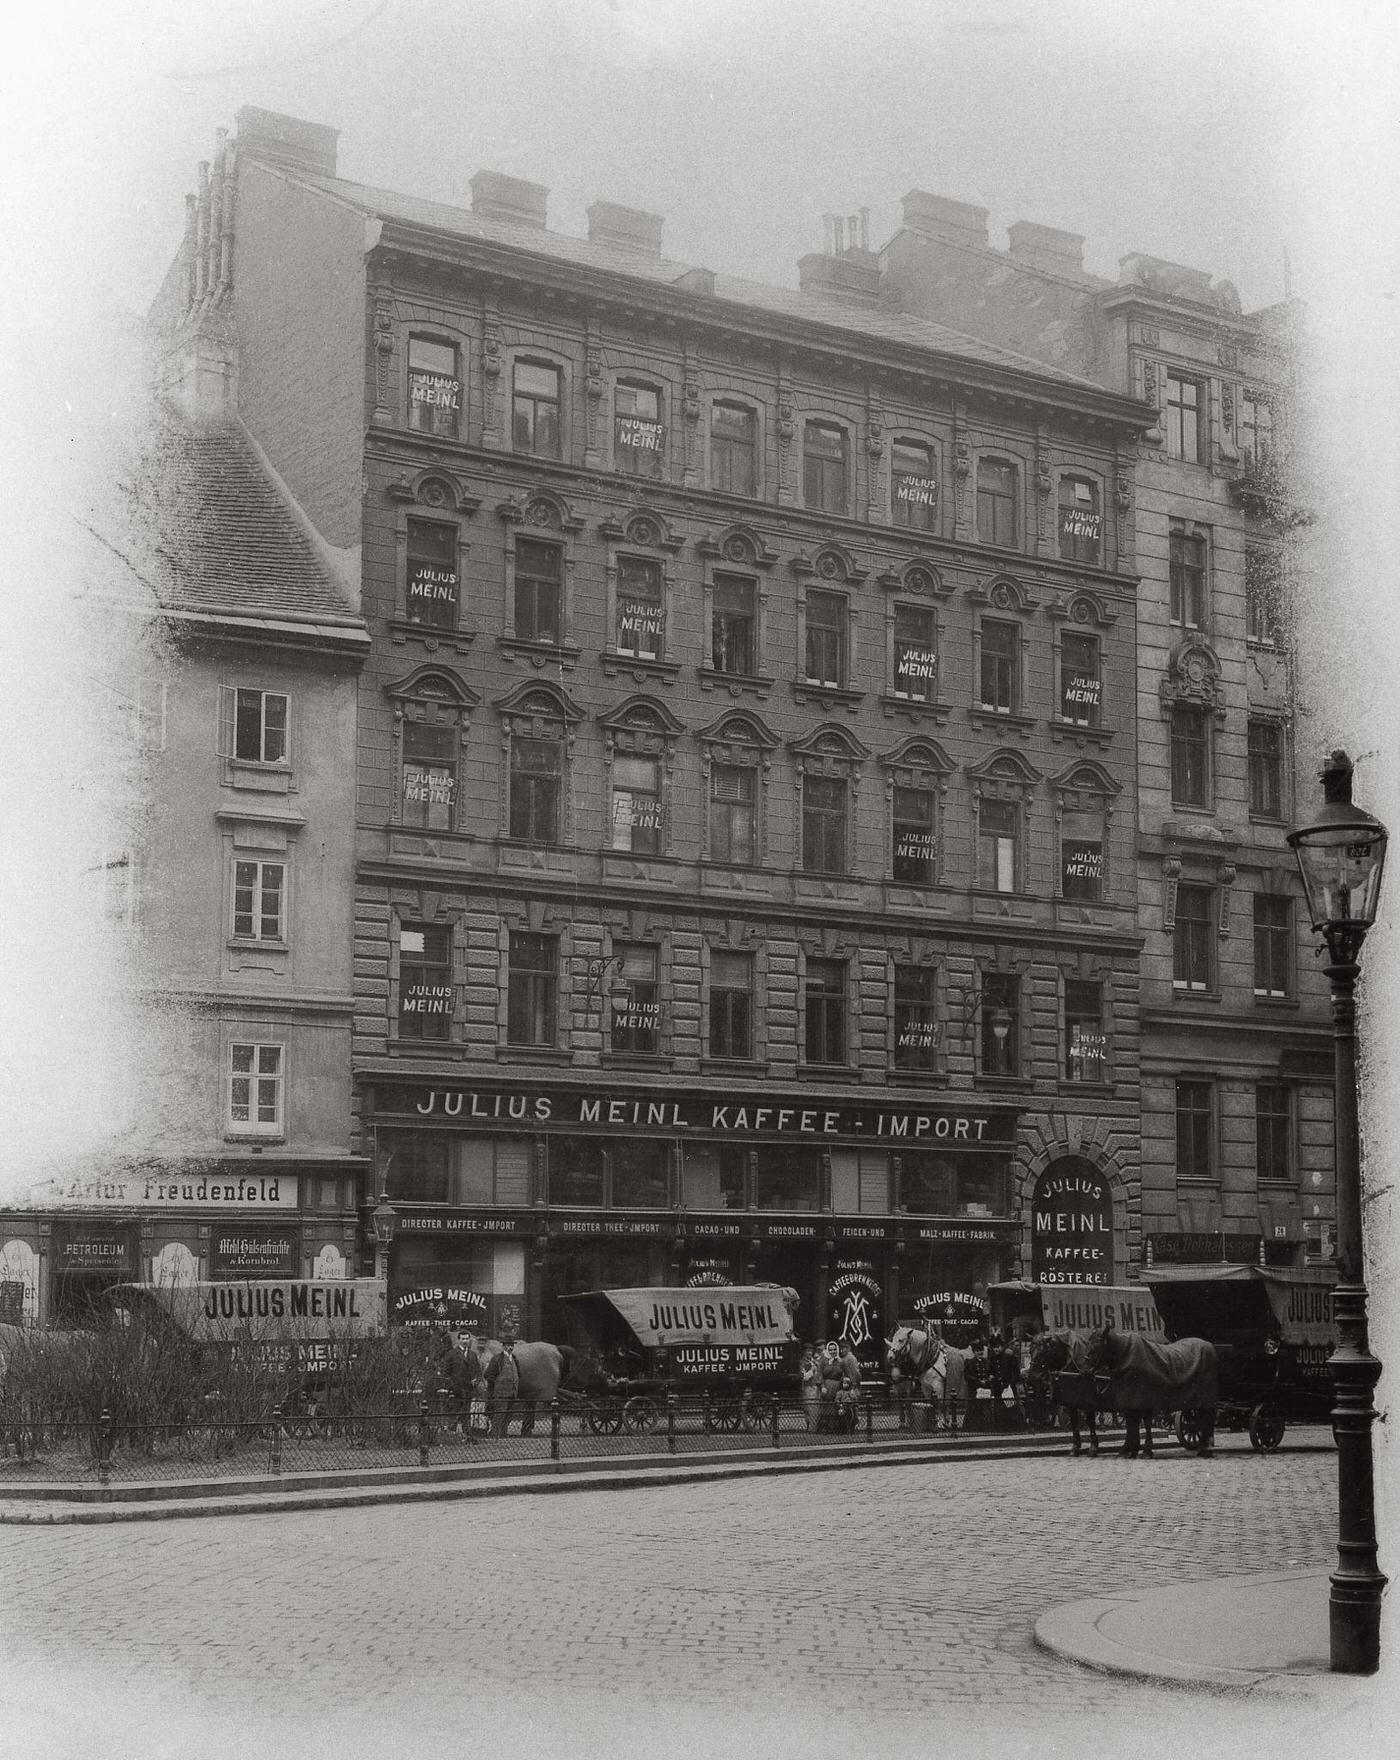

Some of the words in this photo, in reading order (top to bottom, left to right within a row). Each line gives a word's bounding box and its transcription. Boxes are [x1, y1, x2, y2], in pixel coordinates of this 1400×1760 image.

[418, 373, 460, 392] JULIUS
[411, 387, 460, 409] MEINL
[624, 418, 664, 434] JULIUS
[620, 432, 664, 452] MEINL
[902, 474, 937, 490] JULIUS
[897, 487, 937, 506] MEINL
[1068, 509, 1101, 525] JULIUS
[1063, 521, 1100, 540] MEINL
[415, 568, 457, 584] JULIUS
[410, 582, 457, 602] MEINL
[625, 603, 664, 618] JULIUS
[621, 616, 664, 635] MEINL
[902, 649, 937, 664] JULIUS
[898, 661, 936, 680] MEINL
[1070, 676, 1101, 691] JULIUS
[1065, 688, 1100, 705] MEINL
[411, 773, 455, 788] JULIUS
[406, 787, 455, 807] MEINL
[624, 799, 663, 814] ULIUS
[902, 832, 937, 846] JULIUS
[897, 844, 938, 861] MEINL
[1071, 851, 1103, 865] JULIUS
[1066, 864, 1102, 879] MEINL
[408, 984, 452, 998] JULIUS
[403, 998, 454, 1014] MEINL
[616, 1014, 661, 1030] MEINL
[904, 1021, 939, 1033] JULIUS
[898, 1033, 939, 1048] MEINL
[416, 1091, 553, 1120] JULIUS
[579, 1099, 689, 1126] MEINL
[712, 1106, 840, 1134] KAFFEE
[876, 1114, 988, 1140] IMPORT
[143, 1177, 281, 1202] Freudenfeld
[1043, 1178, 1102, 1199] JULIUS
[401, 1219, 442, 1229] DIRECTER
[563, 1222, 600, 1232] DIRECTER
[1036, 1212, 1110, 1232] MEINL
[66, 1244, 124, 1256] PETROLEUM
[1046, 1247, 1105, 1260] KAFFEE-
[1040, 1266, 1108, 1284] RÖSTEREI
[204, 1287, 285, 1320] JULIUS
[290, 1284, 360, 1318] MEINL
[395, 1288, 443, 1310] JULIUS
[448, 1288, 488, 1310] MEINL
[914, 1292, 951, 1310] JULIUS
[954, 1292, 984, 1309] MEINL
[1288, 1288, 1330, 1323] JULIUS
[650, 1303, 716, 1330] JULIUS
[720, 1302, 778, 1330] MEINL
[1054, 1300, 1116, 1330] JULIUS
[1120, 1302, 1162, 1332] MEIN
[676, 1347, 730, 1363] JULIUS
[736, 1347, 783, 1362] MEINL
[683, 1364, 726, 1374] KAFFEE
